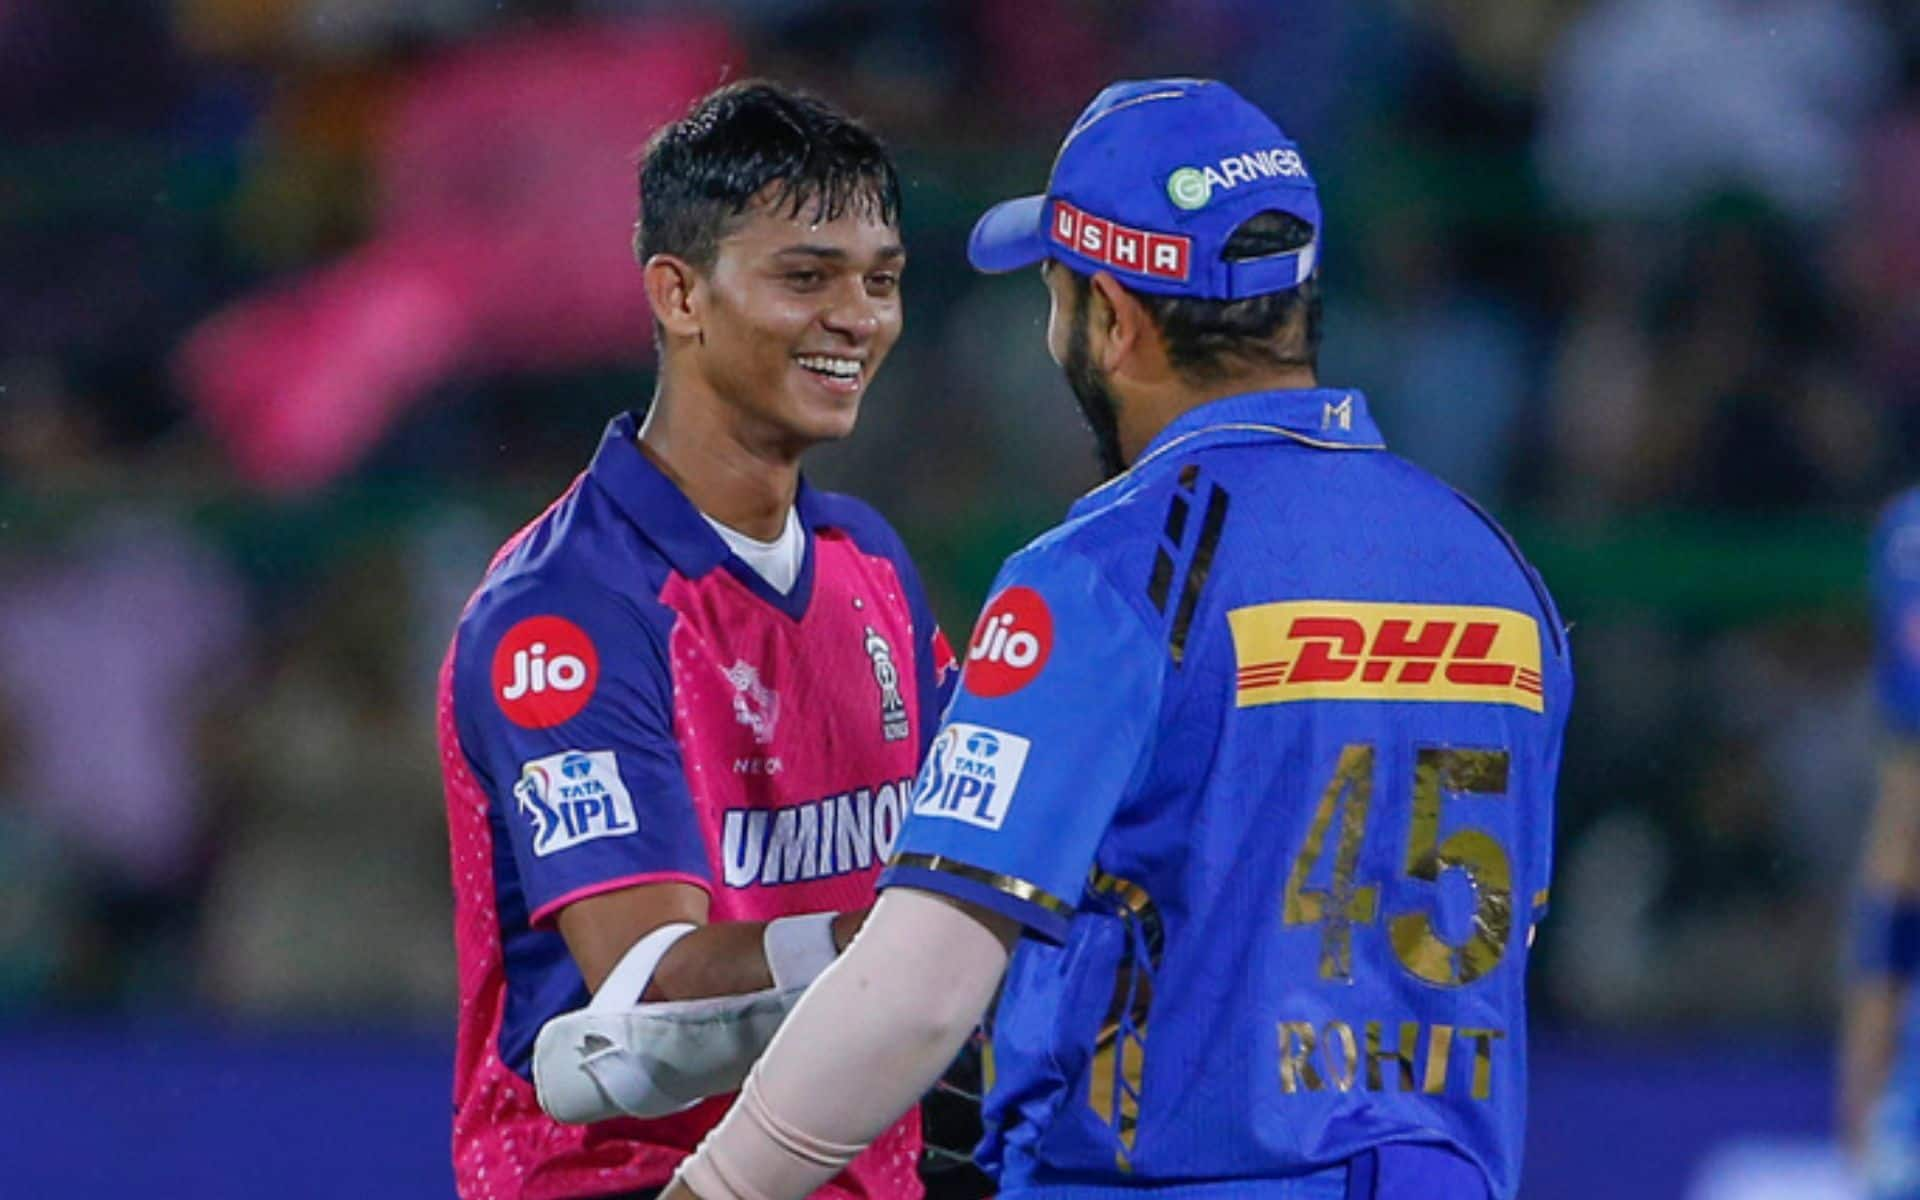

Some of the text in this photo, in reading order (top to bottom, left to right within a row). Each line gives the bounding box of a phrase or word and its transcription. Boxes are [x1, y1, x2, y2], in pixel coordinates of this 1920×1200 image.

[1059, 209, 1179, 271] USHA
[970, 613, 1039, 668] Jio
[1286, 617, 1515, 685] DHL
[503, 643, 585, 700] Jio
[559, 780, 605, 798] TATA
[956, 757, 996, 780] TATA
[559, 793, 630, 838] IPL
[939, 773, 997, 822] IPL
[1282, 744, 1512, 986] 45
[1278, 1020, 1504, 1098] ROHIT
